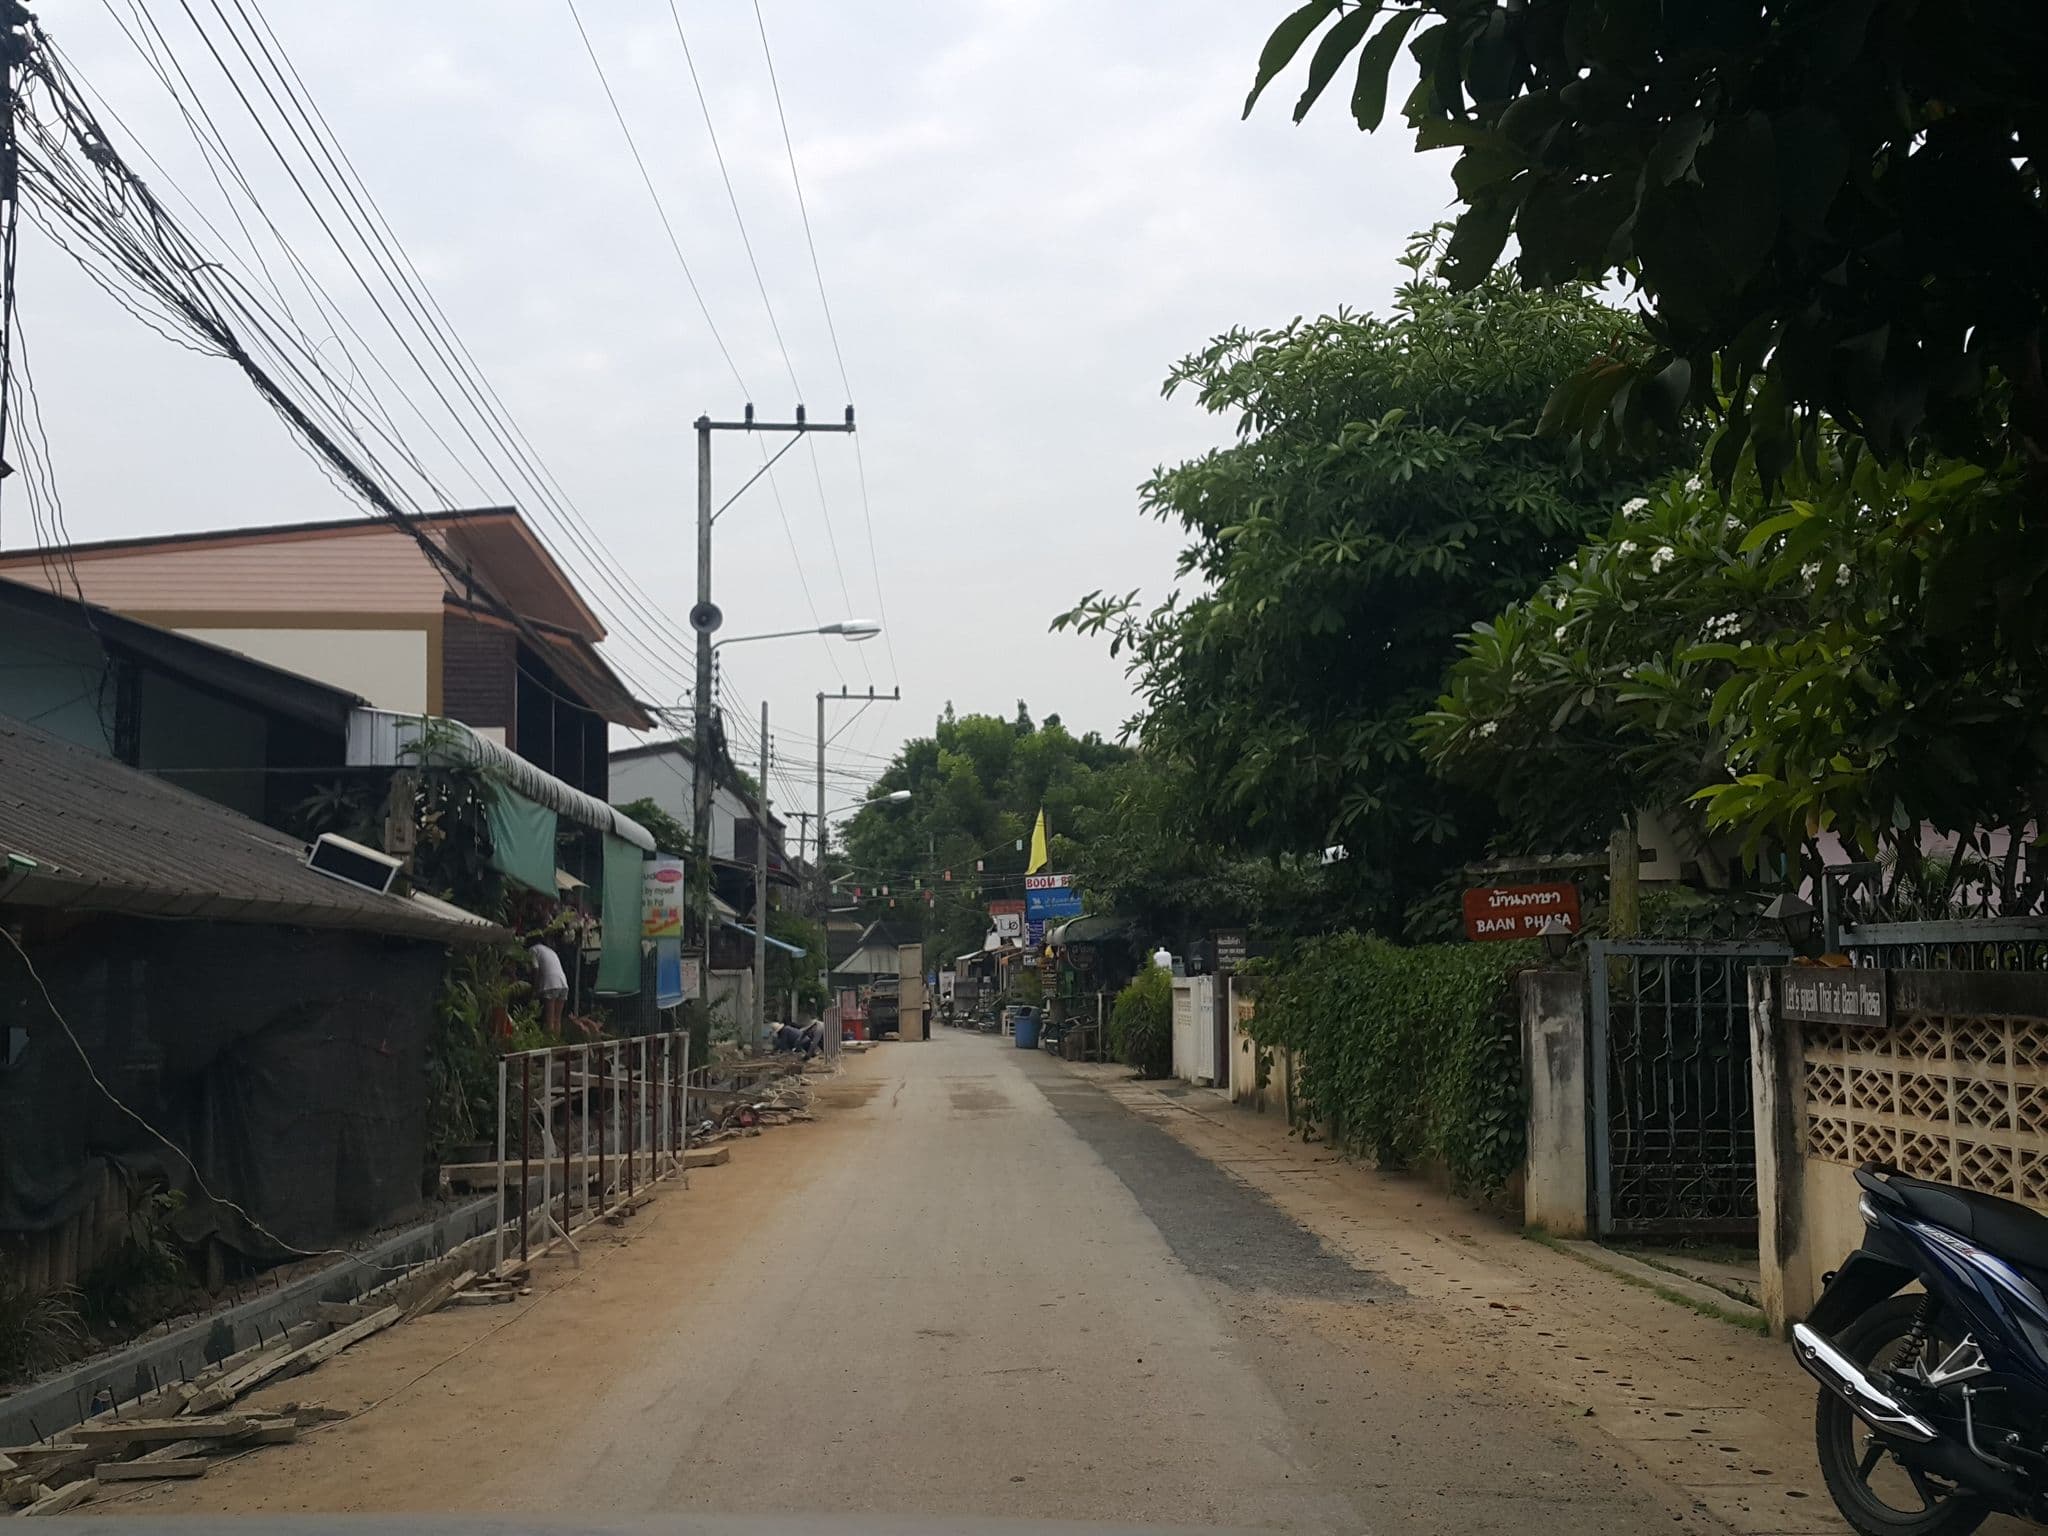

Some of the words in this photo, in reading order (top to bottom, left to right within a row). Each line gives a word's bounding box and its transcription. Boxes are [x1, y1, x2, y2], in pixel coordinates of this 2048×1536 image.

[1489, 890, 1560, 908] บ้านภาษา
[1476, 917, 1516, 933] BAAN
[1785, 980, 1799, 1010] Let's
[1800, 981, 1818, 1019] speak
[1833, 985, 1841, 1013] at
[1841, 982, 1859, 1014] Baan
[1859, 983, 1881, 1017] Phasa
